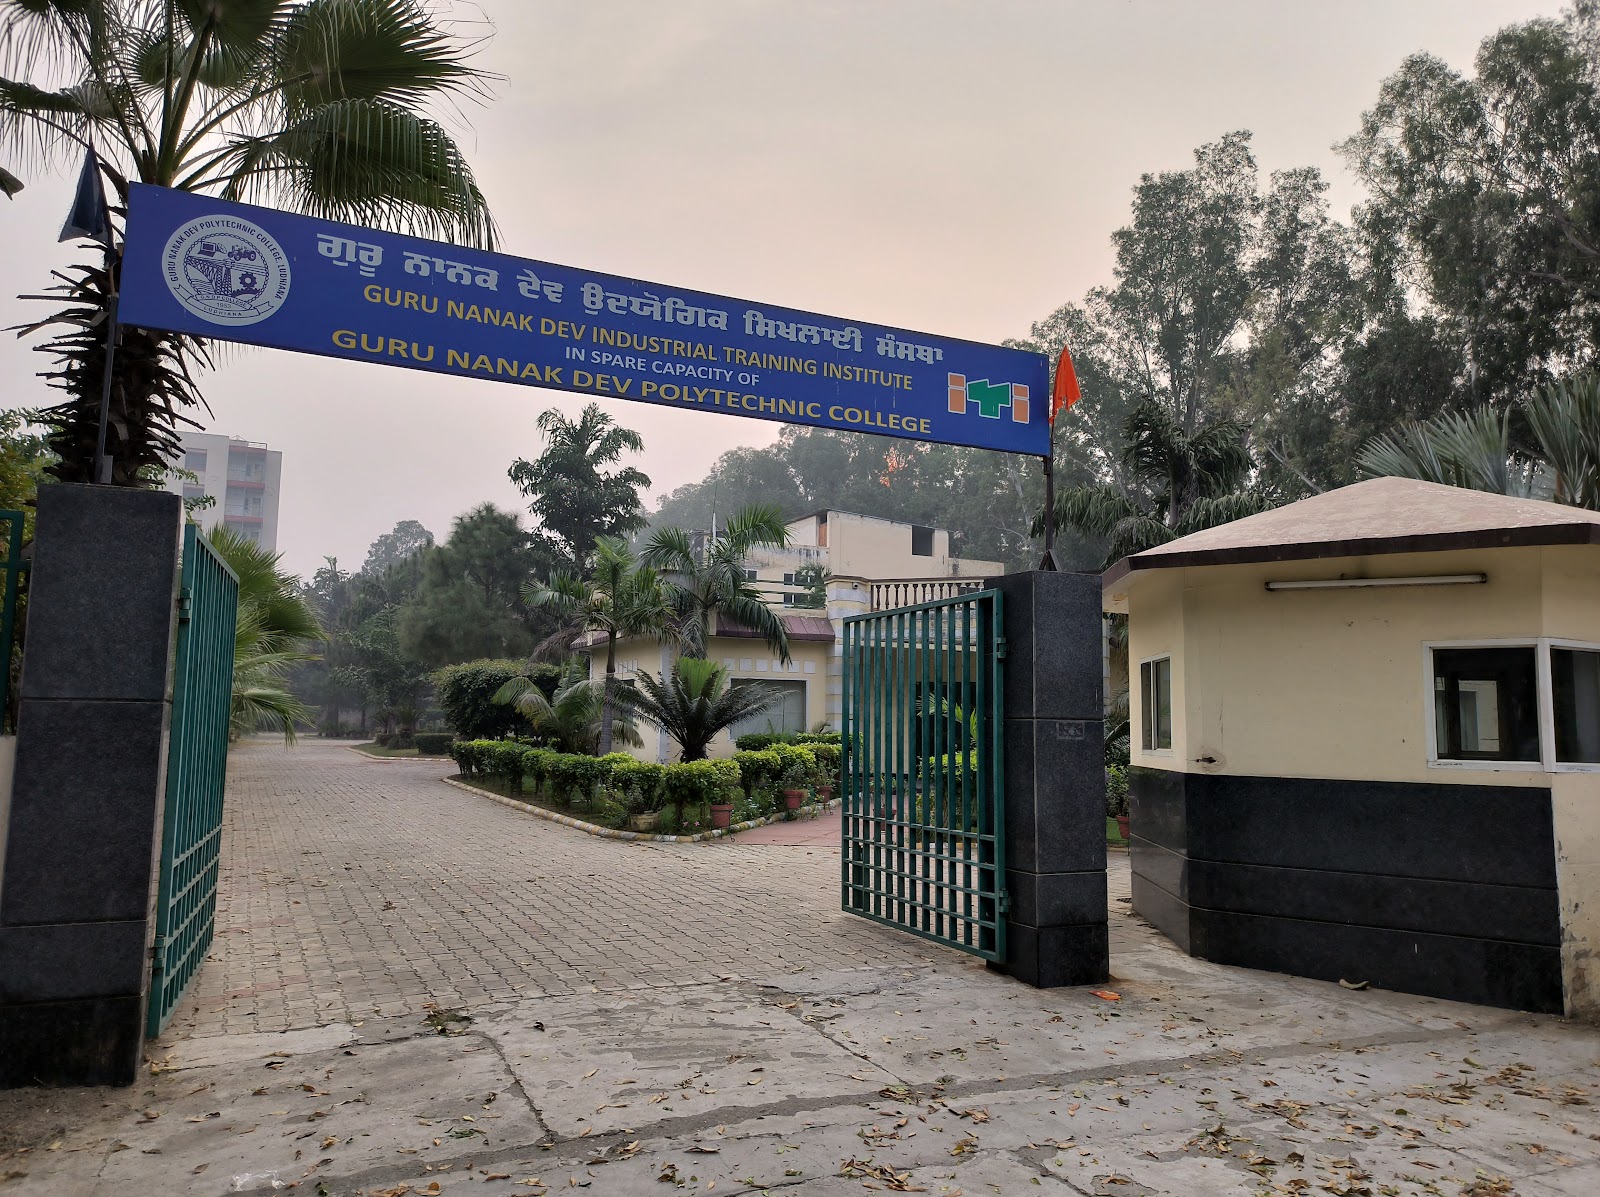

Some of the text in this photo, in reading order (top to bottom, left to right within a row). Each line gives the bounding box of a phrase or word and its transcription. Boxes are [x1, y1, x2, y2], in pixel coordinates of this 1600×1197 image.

[183, 224, 199, 238] DEV
[199, 220, 257, 236] POLYTECHNIC
[168, 233, 187, 260] NANAK
[167, 261, 179, 282] GURU
[275, 264, 288, 300] LUDHIANA
[316, 233, 384, 278] ਗੁਰੂ
[402, 251, 500, 292] ਨਾਨਕ
[516, 268, 565, 304] ਦੇਵ
[742, 310, 864, 353] ਸਿਖਲਾਈ
[875, 333, 944, 365] ਸੰਸਥਾ
[363, 284, 914, 391] GURU NANAK DEV INDUSTRIAL TRAINING INSTITUTE
[331, 329, 933, 435] GURU NANAK DEV POLYTECHNIC COLLEGE
[565, 346, 761, 387] IN SPARE CAPACITY OF
